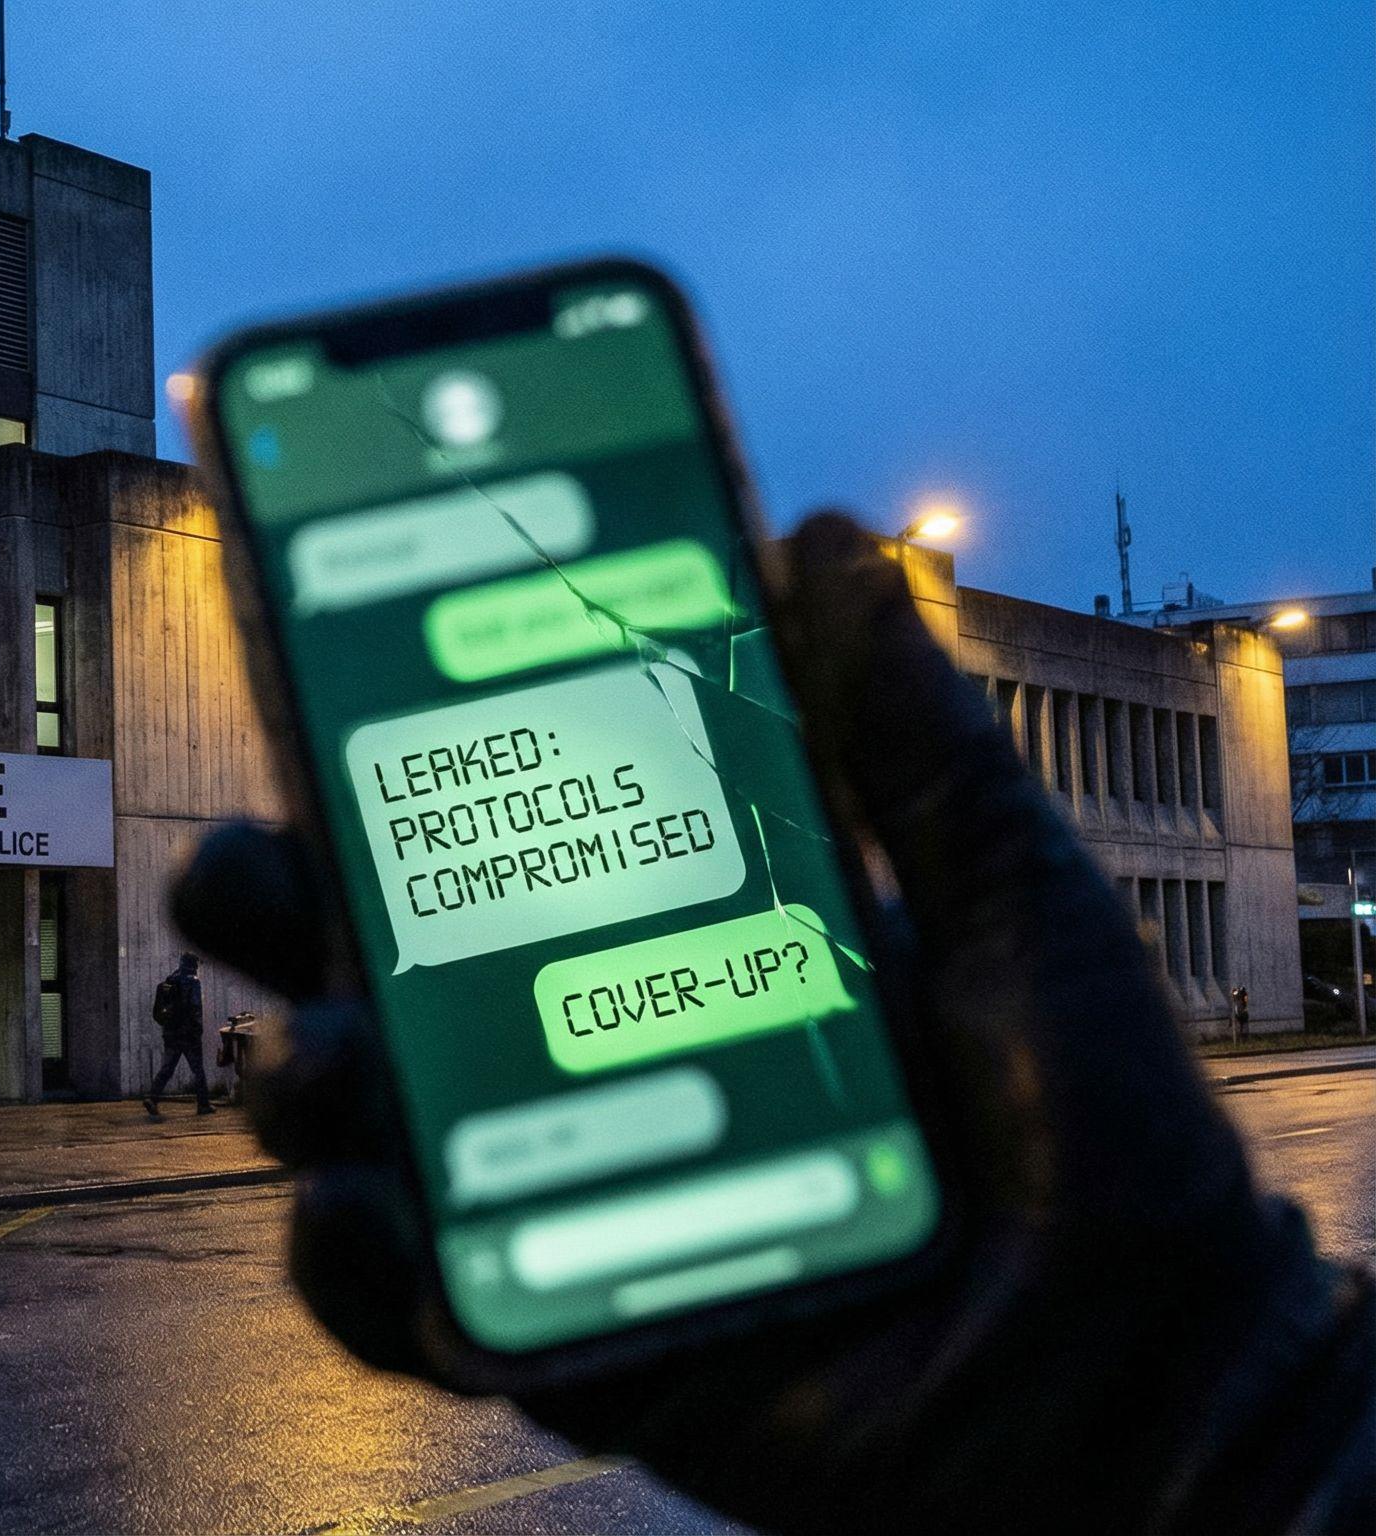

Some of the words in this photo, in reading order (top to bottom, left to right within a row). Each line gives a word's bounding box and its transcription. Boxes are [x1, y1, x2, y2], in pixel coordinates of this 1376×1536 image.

[374, 728, 562, 804] LEAKED:
[389, 764, 645, 861] PROTOCOLS
[406, 809, 715, 918] COMPROMISED
[562, 941, 810, 1038] COVER-UP?
